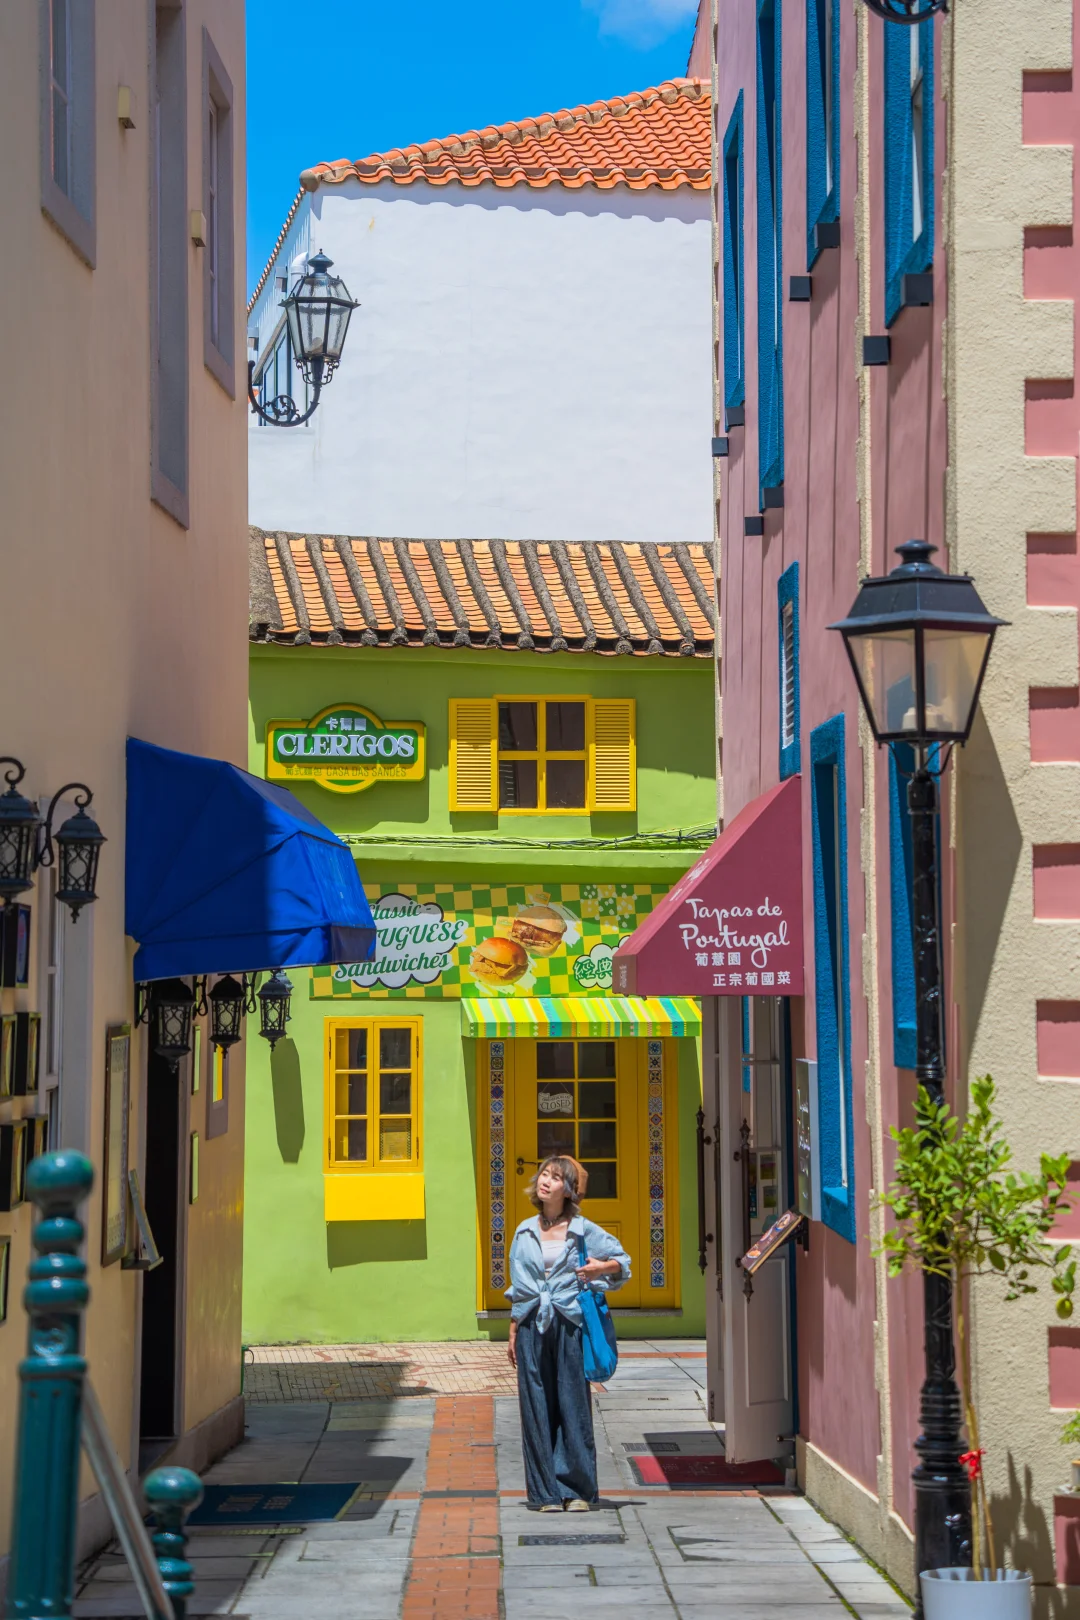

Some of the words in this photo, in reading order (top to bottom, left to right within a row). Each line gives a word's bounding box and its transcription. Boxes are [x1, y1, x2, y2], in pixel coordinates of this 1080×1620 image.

[276, 733, 415, 757] CLERIGOS
[326, 766, 349, 777] CASA
[352, 766, 369, 777] DAS
[371, 766, 407, 777] SANDES
[685, 898, 753, 931] Tapas
[756, 896, 782, 917] de
[376, 921, 464, 950] UGUESE
[678, 920, 790, 969] Portugal
[334, 952, 450, 979] Sandwiches
[712, 970, 791, 987] 正宗葡國菜
[540, 1099, 571, 1110] CLOSED
